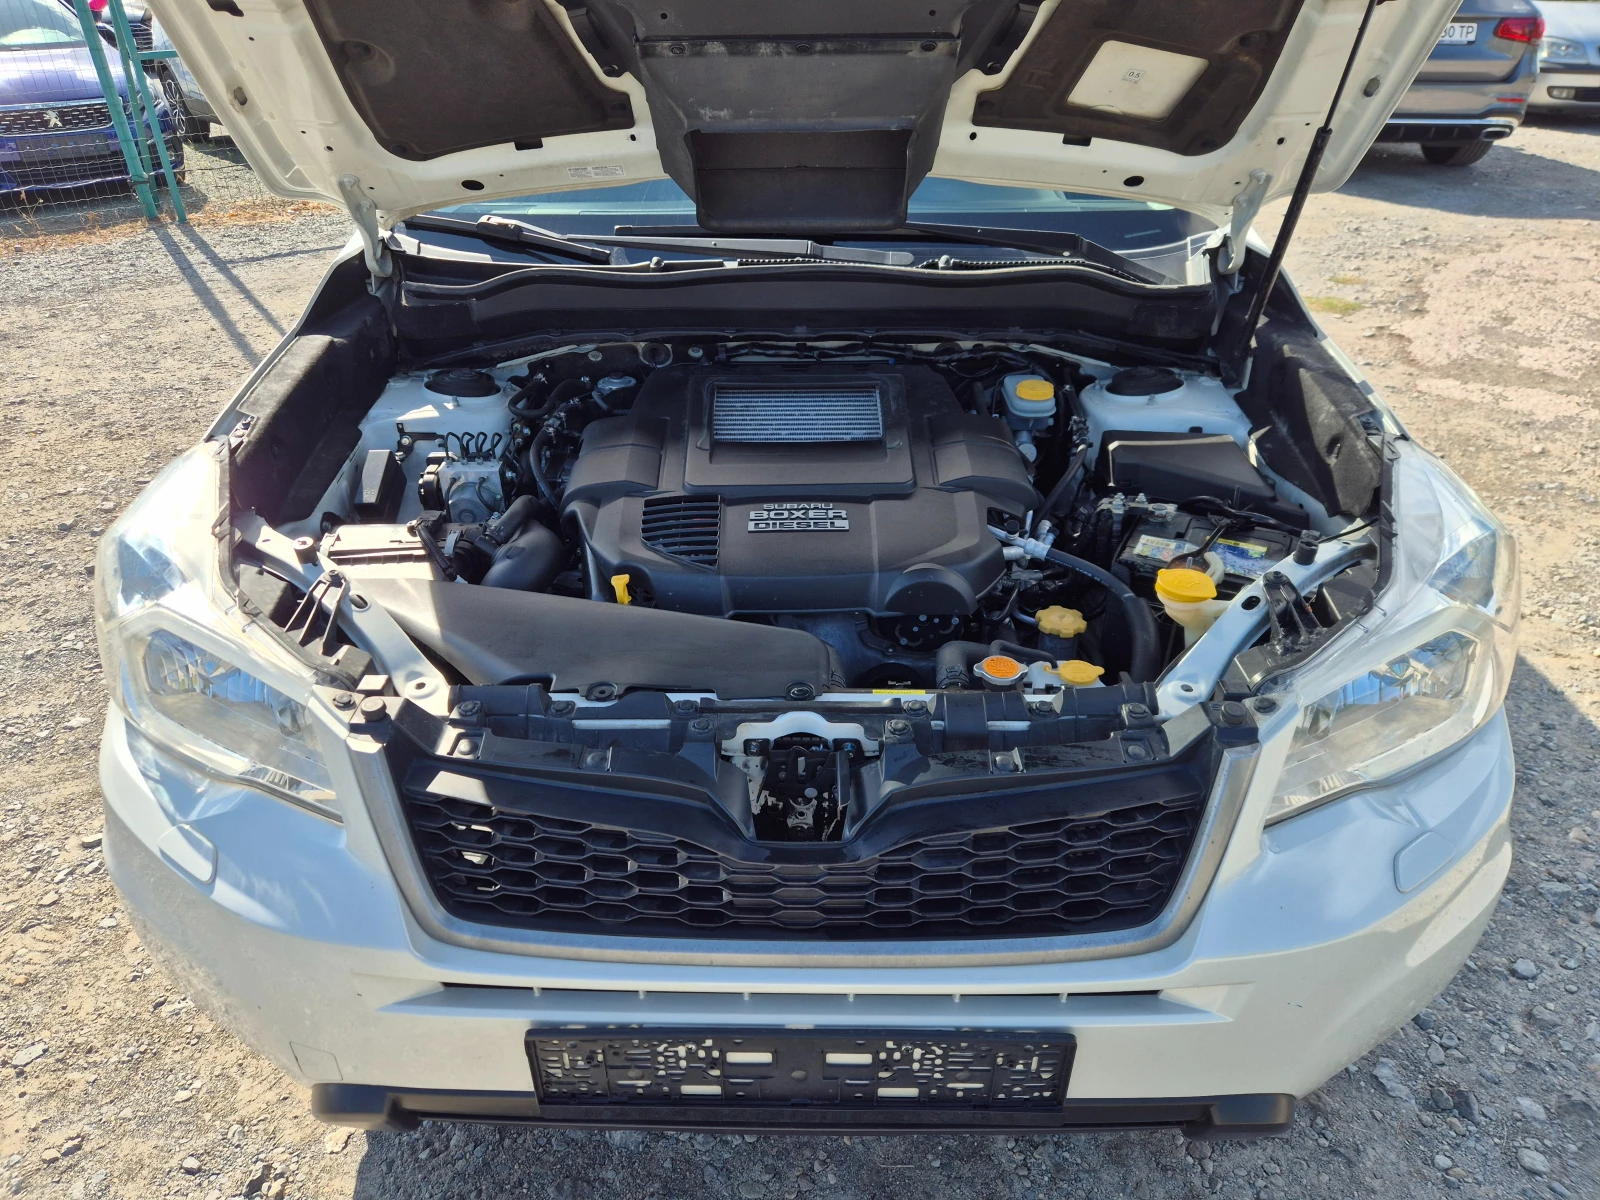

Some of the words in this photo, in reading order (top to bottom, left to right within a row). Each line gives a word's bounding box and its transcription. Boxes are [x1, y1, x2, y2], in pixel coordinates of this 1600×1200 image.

[1459, 25, 1474, 38] TP
[1128, 71, 1141, 79] 0.5
[750, 510, 847, 520] BOXER
[753, 521, 846, 530] DIESEL
